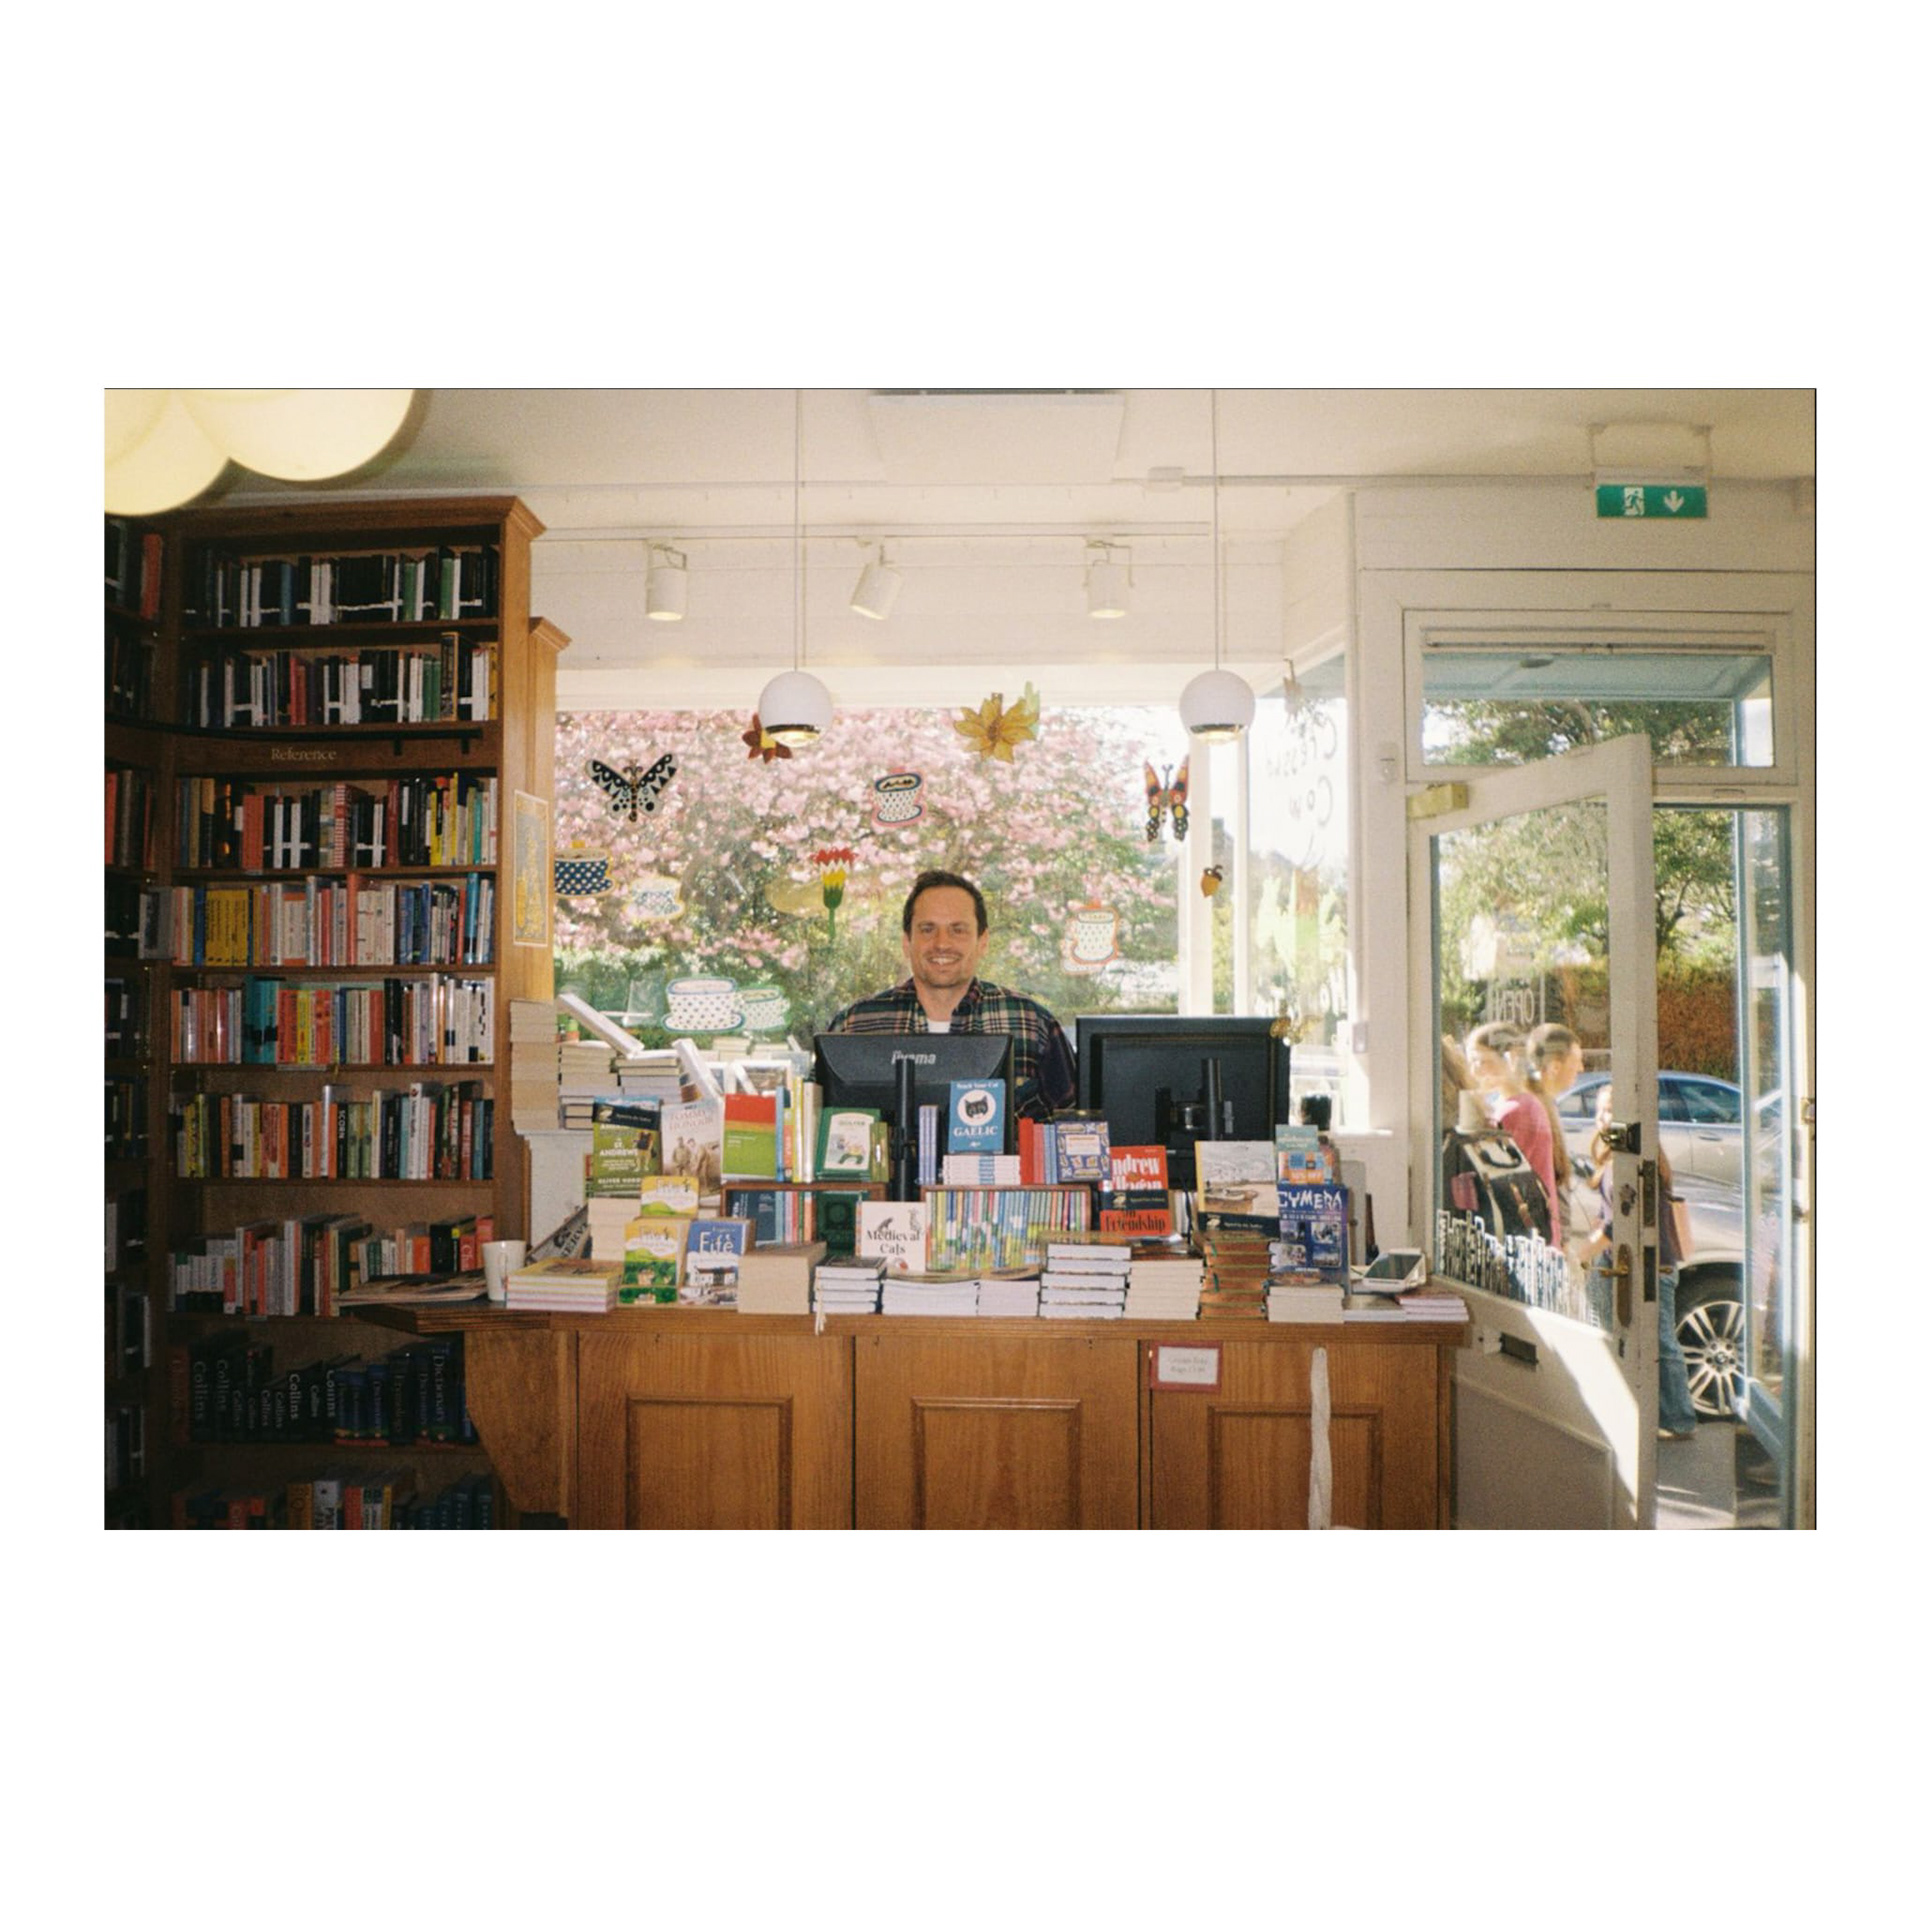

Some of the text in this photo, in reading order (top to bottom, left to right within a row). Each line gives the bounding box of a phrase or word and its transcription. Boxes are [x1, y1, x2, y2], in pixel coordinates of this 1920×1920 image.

[271, 746, 337, 761] Reference
[953, 1125, 998, 1137] GAELIC
[1111, 1153, 1160, 1175] ndrew
[1276, 1190, 1342, 1210] CYMERA
[867, 1229, 920, 1241] Medieval
[1106, 1213, 1166, 1234] Friendship
[700, 1231, 734, 1254] Fife
[880, 1243, 906, 1256] Cats
[193, 1360, 209, 1421] Collins
[216, 1358, 230, 1412] Collins
[433, 1355, 446, 1423] Dictionary
[260, 1389, 271, 1427] Collins
[288, 1373, 300, 1421] Collins
[309, 1385, 319, 1419] Collins
[273, 1391, 284, 1429] Collins
